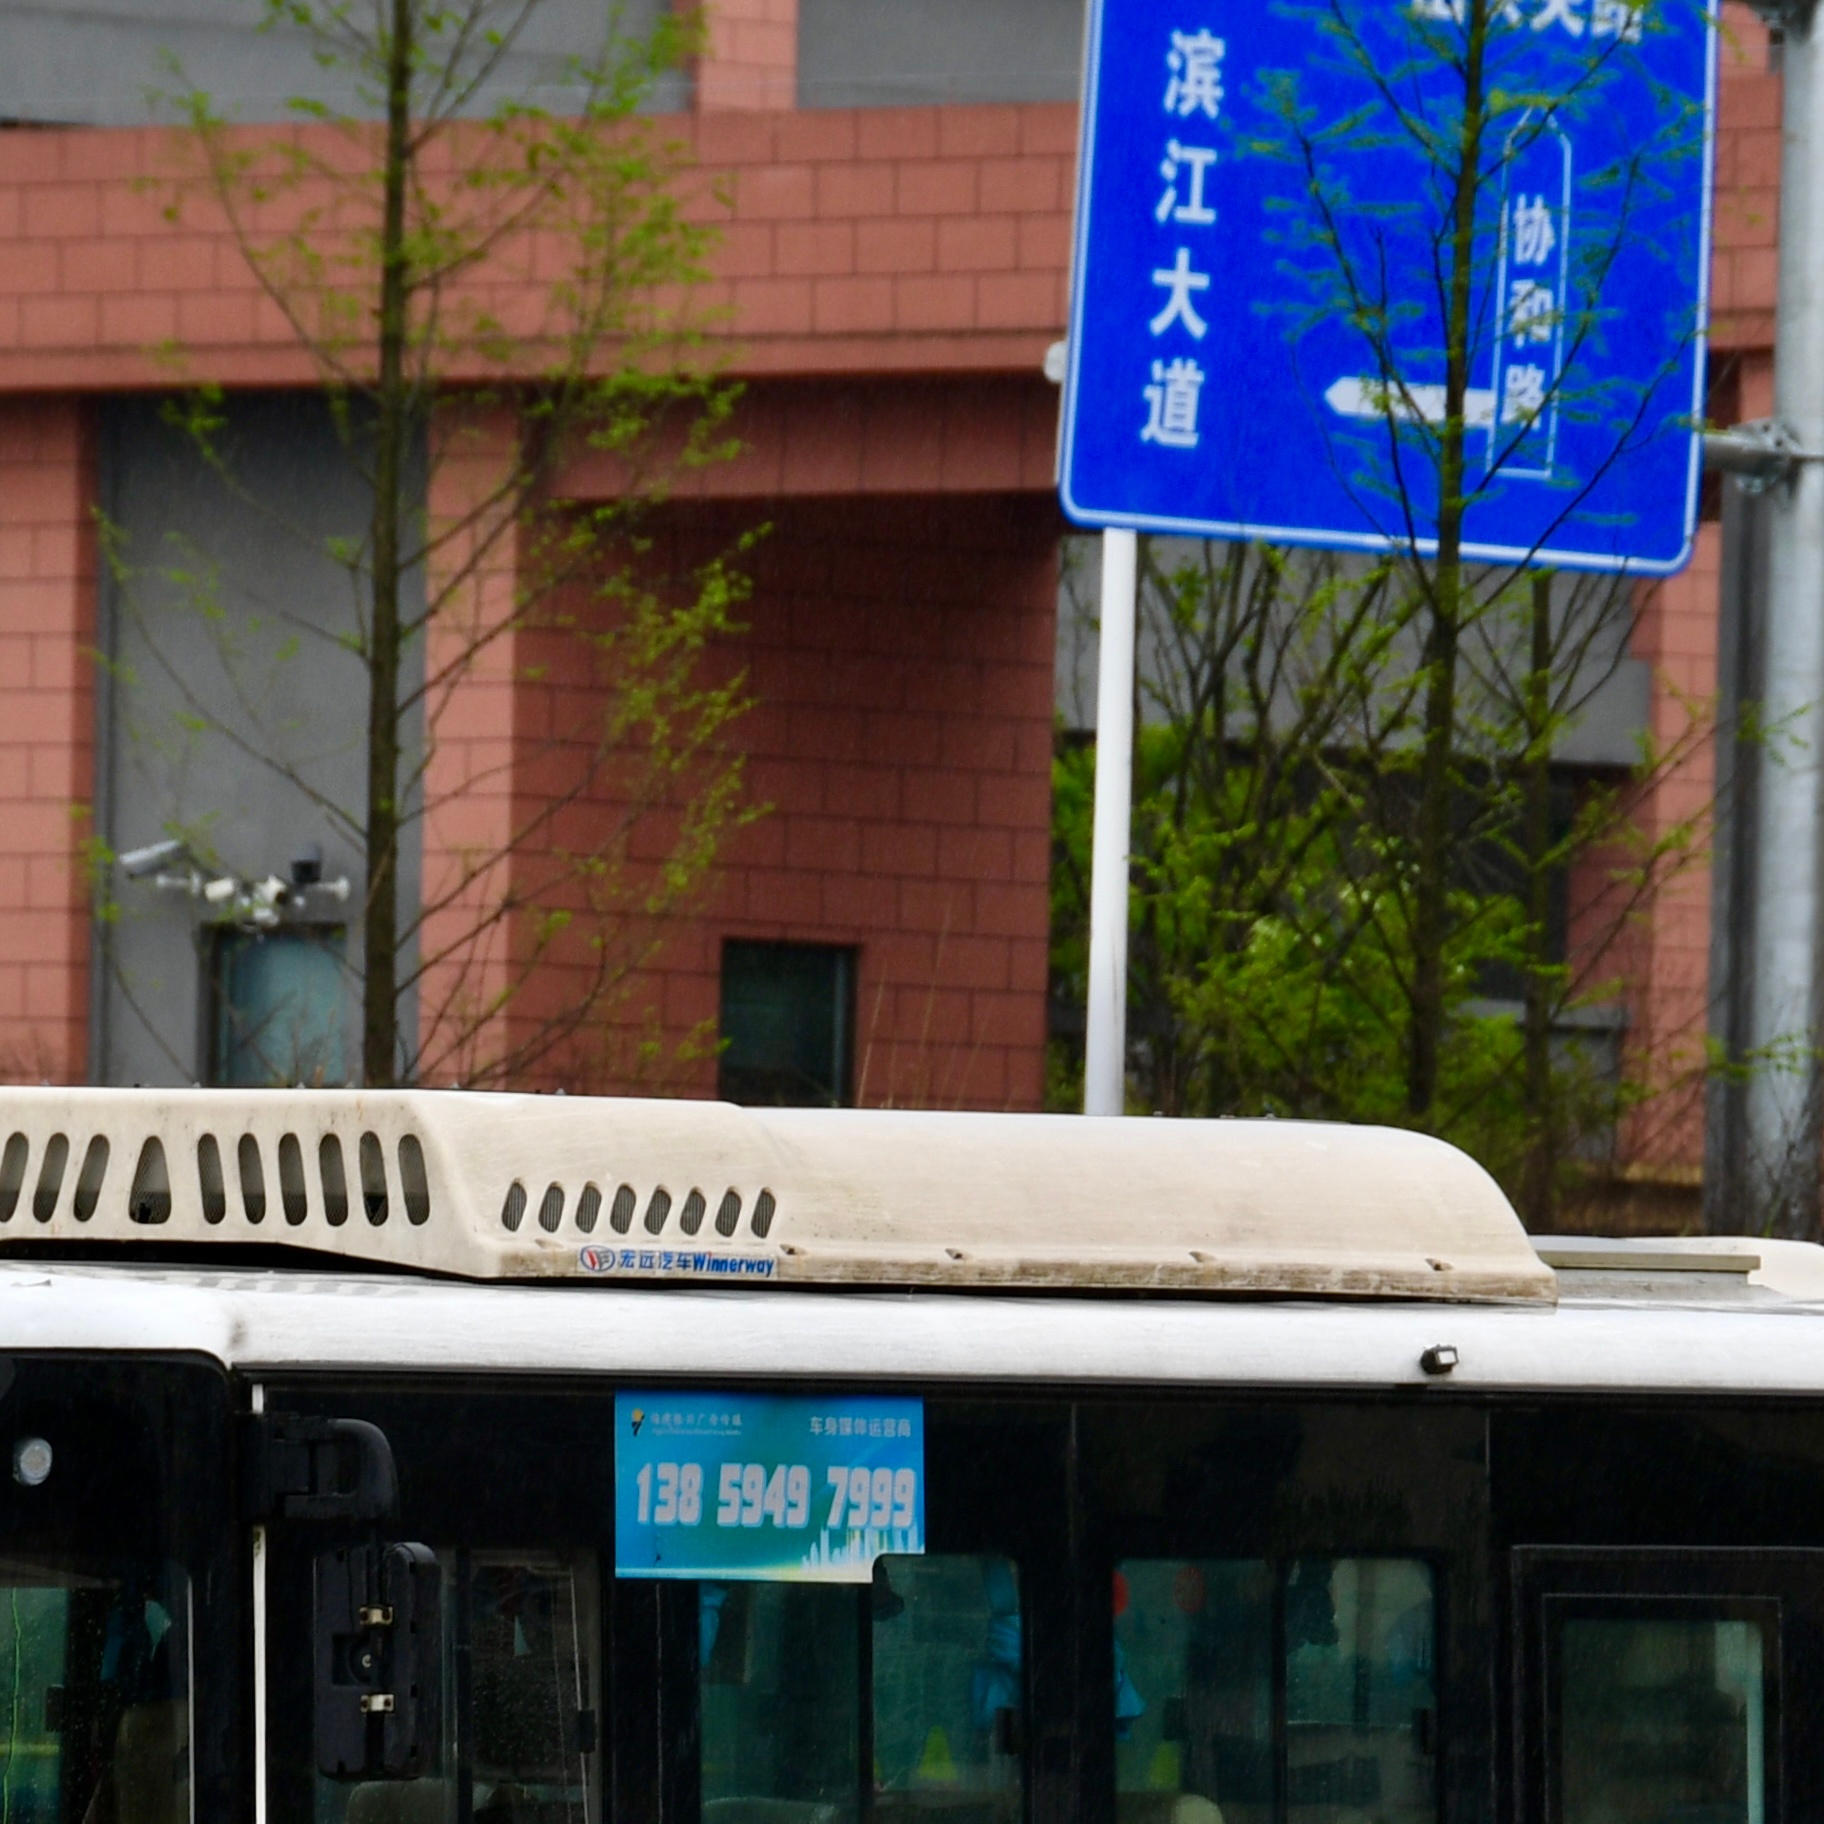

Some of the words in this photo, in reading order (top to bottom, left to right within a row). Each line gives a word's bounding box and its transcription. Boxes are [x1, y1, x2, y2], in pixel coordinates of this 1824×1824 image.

[1141, 30, 1226, 449] 滨江大道
[619, 1249, 692, 1270] 宏远汽车
[692, 1251, 775, 1277] Winnerway
[636, 1462, 703, 1527] 138
[716, 1462, 811, 1528] 5949
[826, 1465, 917, 1529] 7999
